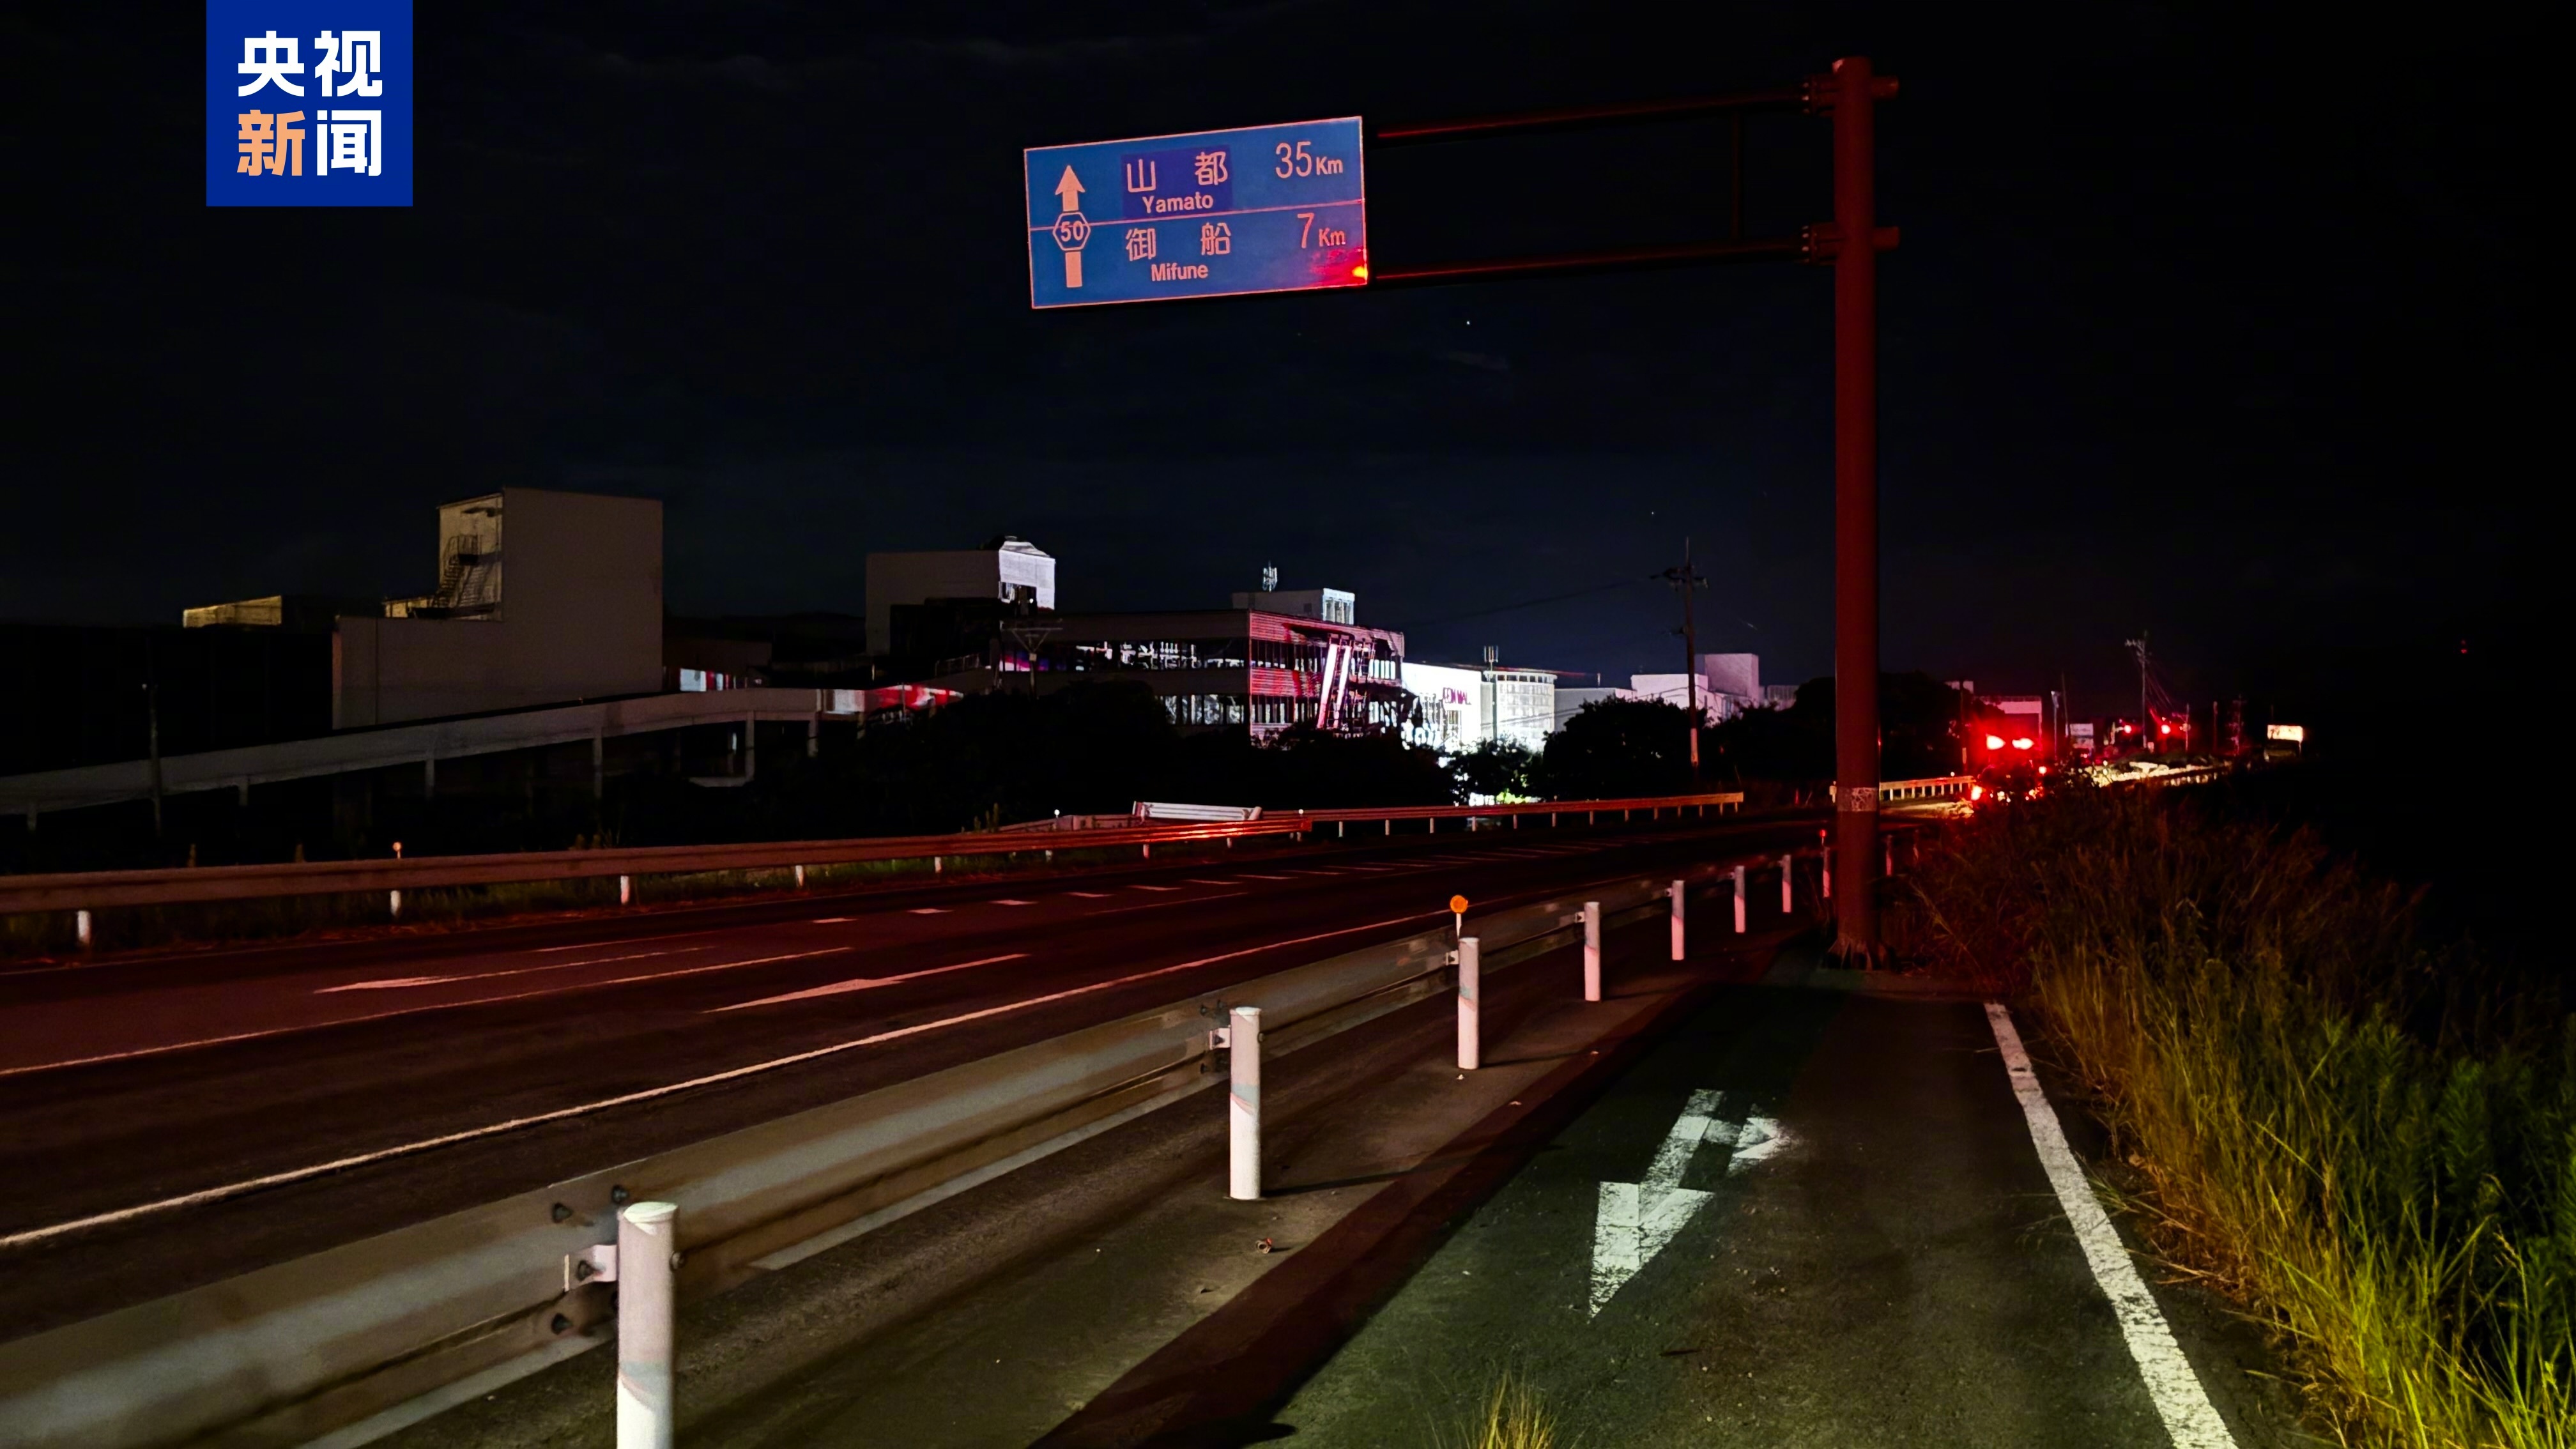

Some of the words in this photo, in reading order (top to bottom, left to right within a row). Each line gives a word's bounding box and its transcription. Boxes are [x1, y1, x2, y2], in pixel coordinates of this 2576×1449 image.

[1142, 191, 1214, 214] Yamato
[1061, 220, 1084, 242] 50
[1151, 262, 1209, 282] Mifune
